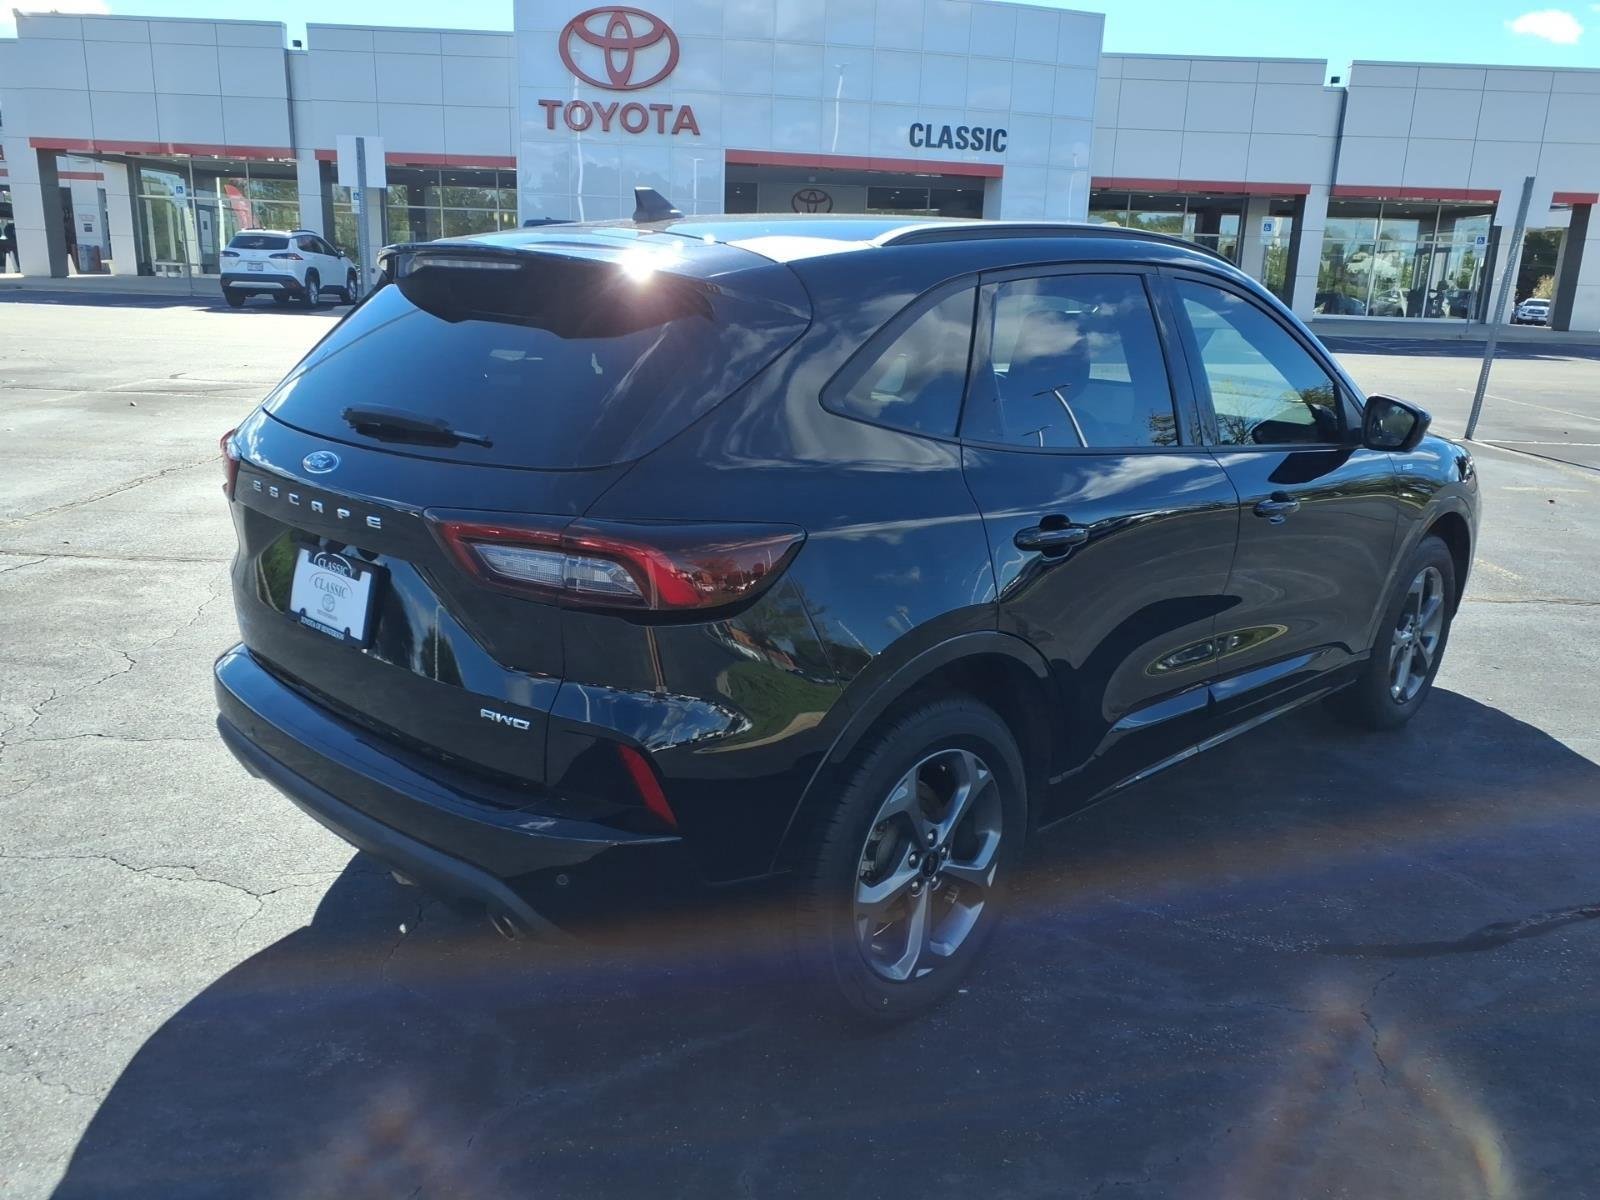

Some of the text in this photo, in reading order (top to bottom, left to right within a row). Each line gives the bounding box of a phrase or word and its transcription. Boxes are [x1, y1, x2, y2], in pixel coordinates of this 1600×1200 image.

[538, 99, 701, 136] TOYOTA
[909, 122, 1008, 153] CLASSIC
[252, 480, 382, 529] ESCAPE
[317, 557, 348, 577] CLASSIC
[313, 576, 348, 601] CLASSIC
[480, 708, 531, 730] AWD
